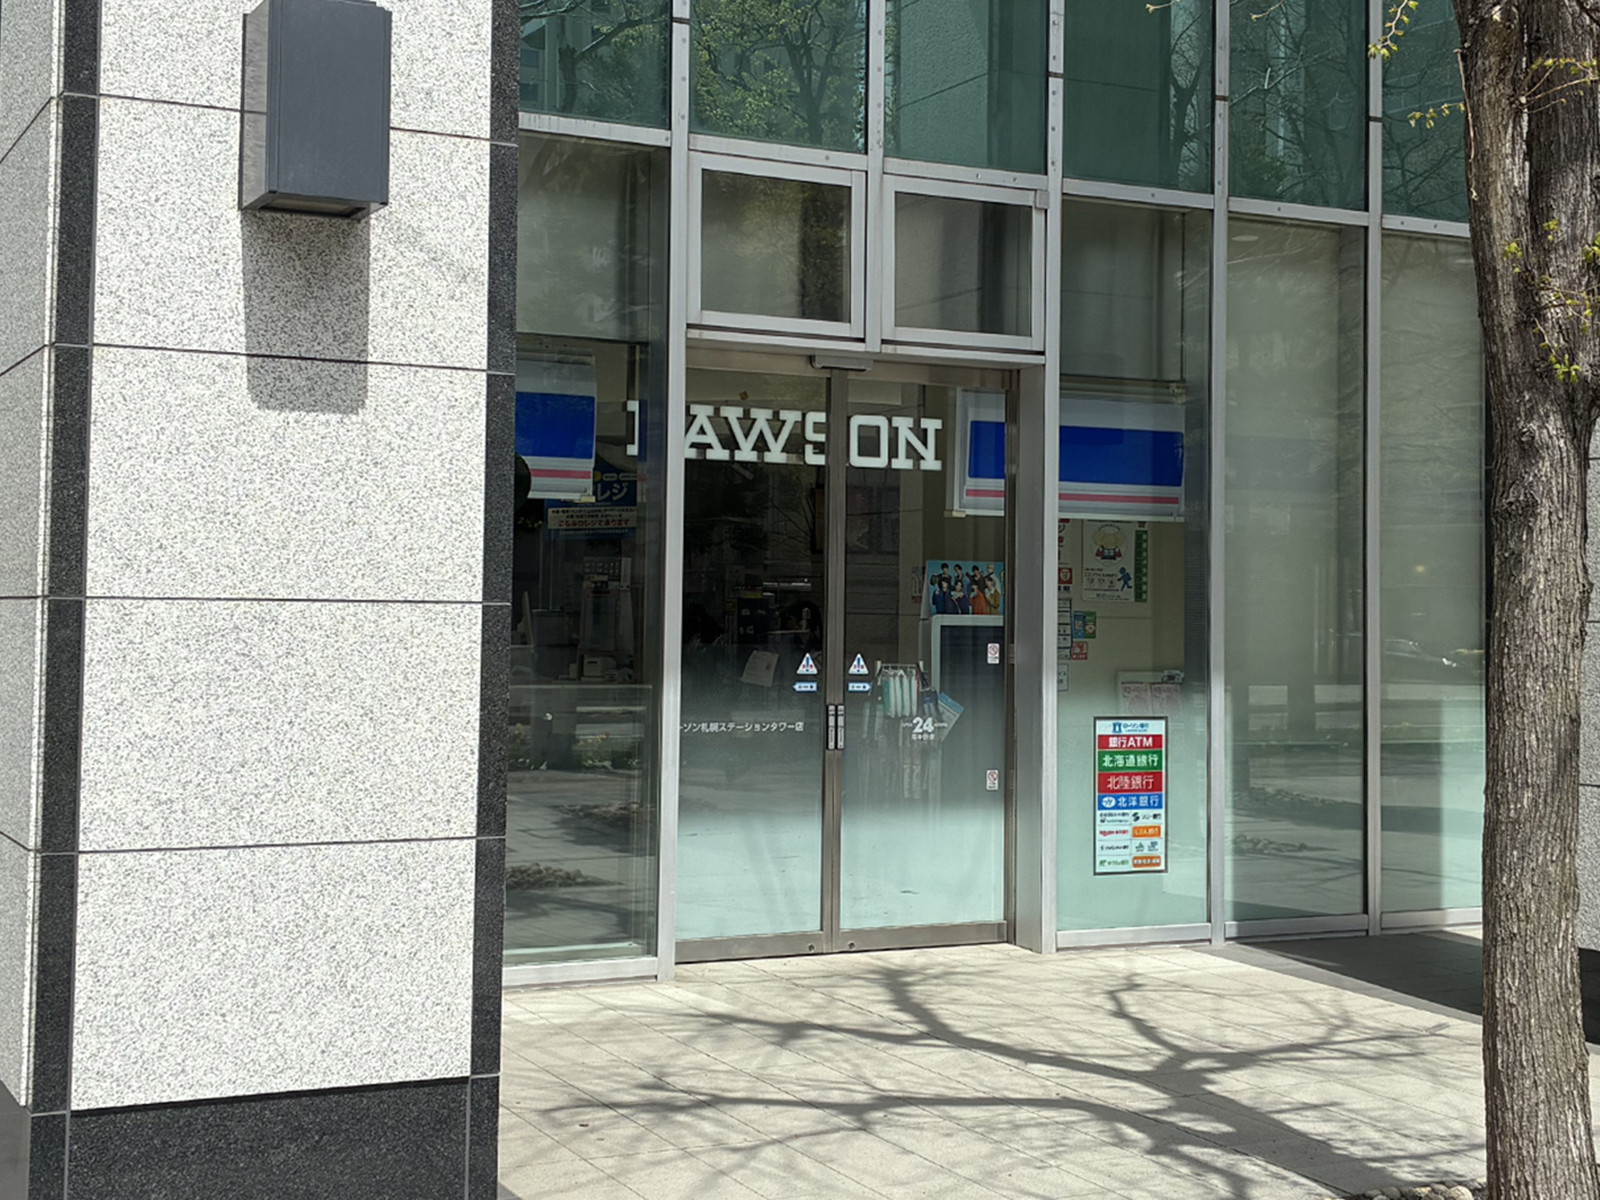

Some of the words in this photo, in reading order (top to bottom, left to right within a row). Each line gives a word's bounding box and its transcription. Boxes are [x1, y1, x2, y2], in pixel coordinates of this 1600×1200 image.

[912, 716, 935, 733] 24
[1108, 736, 1153, 748] 銀行ATM
[1102, 753, 1159, 768] 北海道銀行
[1106, 775, 1154, 790] 北陸銀行
[1117, 795, 1159, 808] 北洋銀行
